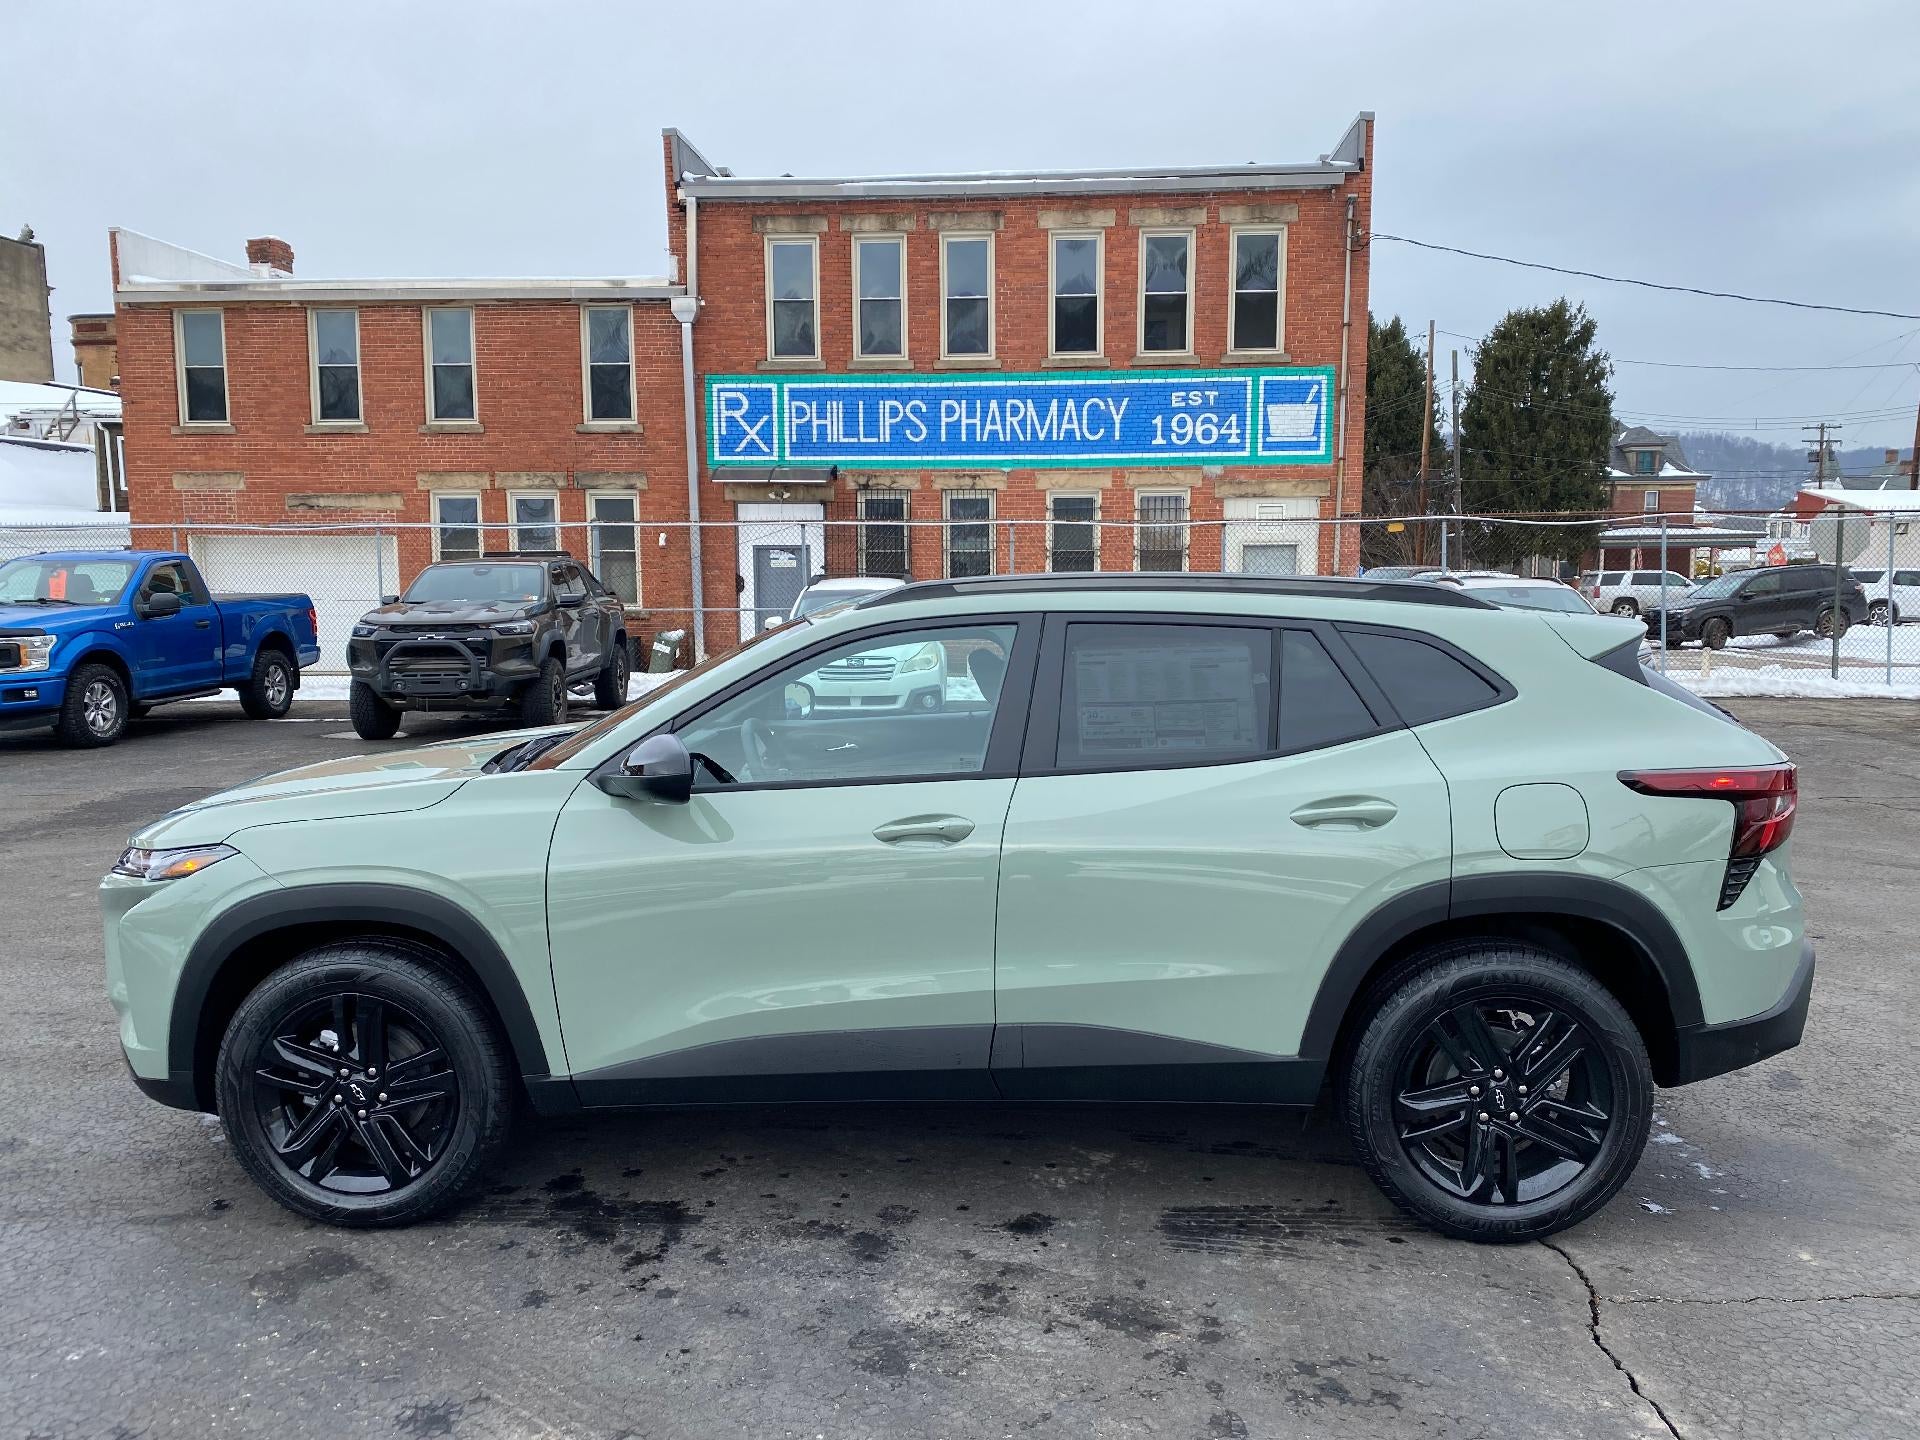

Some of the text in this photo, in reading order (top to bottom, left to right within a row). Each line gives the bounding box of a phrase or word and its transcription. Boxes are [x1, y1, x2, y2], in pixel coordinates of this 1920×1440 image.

[1171, 391, 1218, 408] EST
[791, 397, 1129, 442] PHILLIPS PHARMACY
[1151, 413, 1240, 445] 1964
